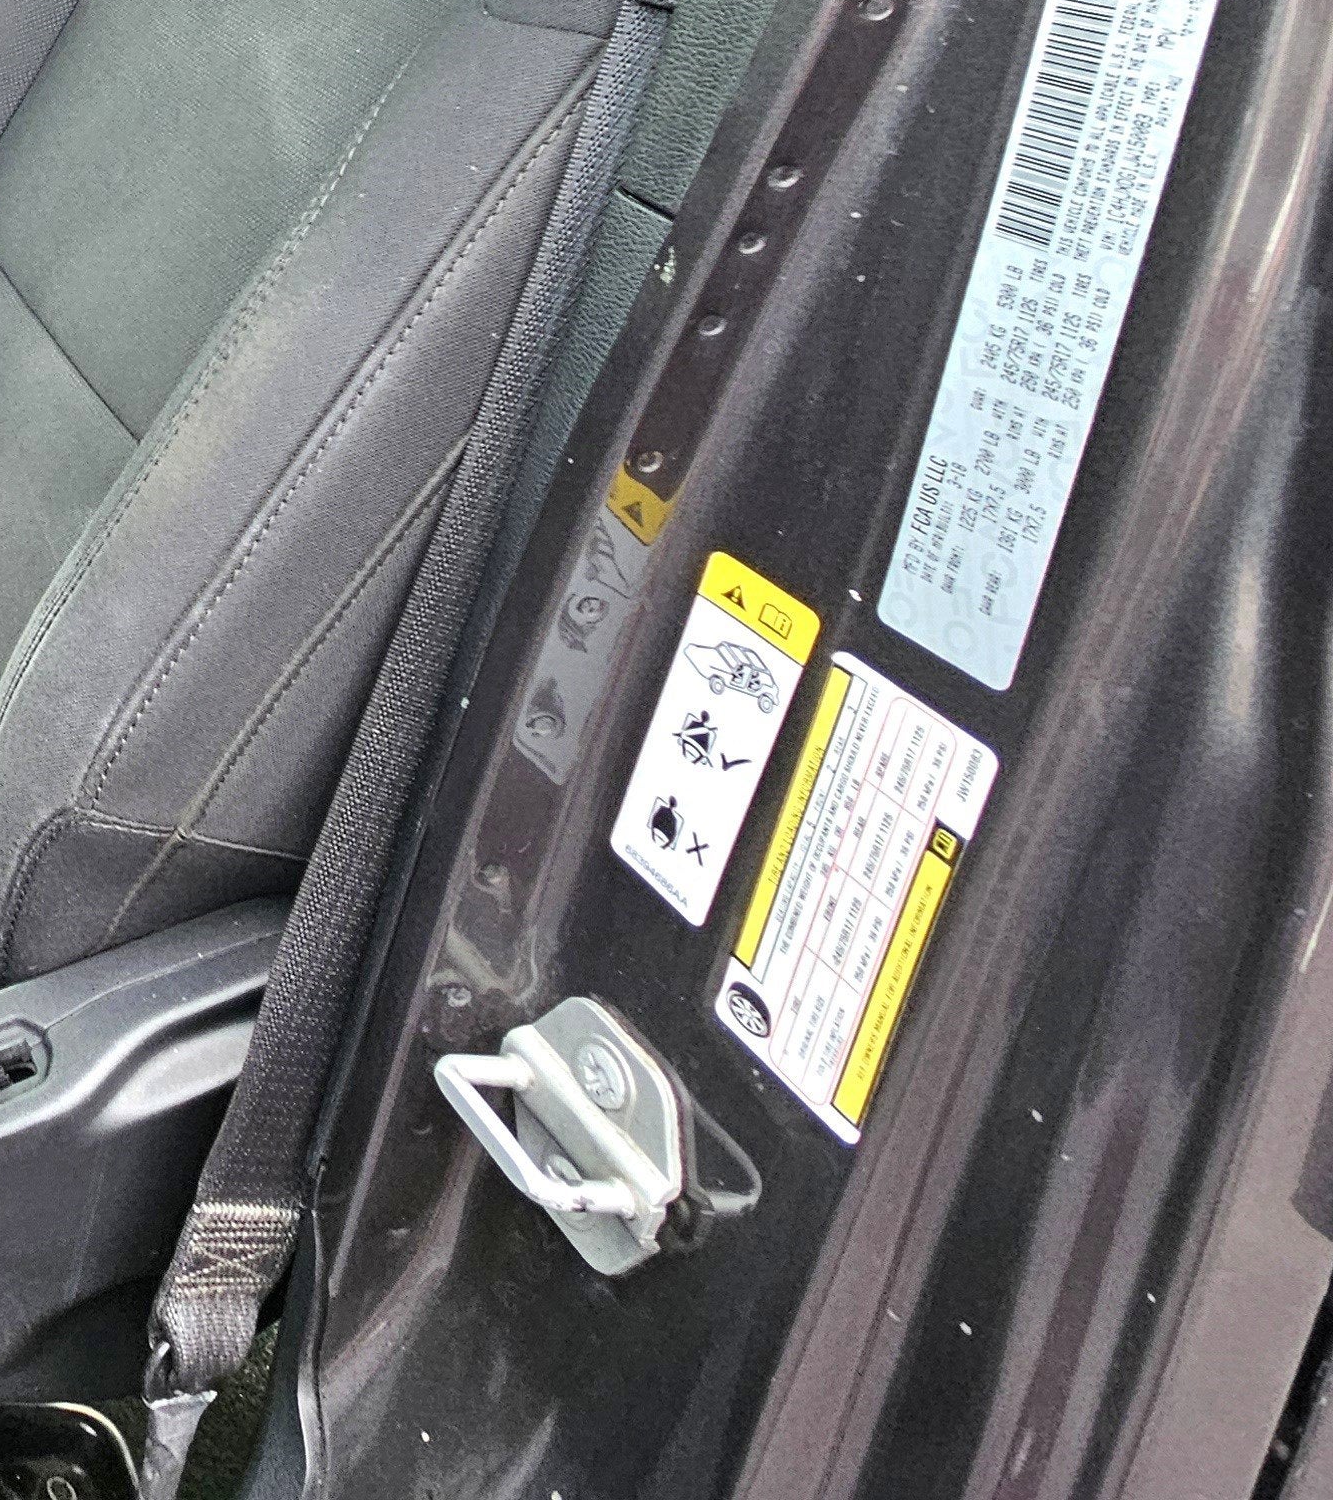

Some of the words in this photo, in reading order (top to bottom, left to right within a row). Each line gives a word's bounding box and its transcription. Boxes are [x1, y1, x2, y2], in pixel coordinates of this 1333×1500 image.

[1117, 2, 1141, 35] FEDERAL
[1132, 32, 1151, 53] DATE
[1155, 27, 1177, 50] MPV
[1127, 57, 1144, 71] THE
[1095, 72, 1120, 121] APPLICABLE
[1113, 90, 1134, 121] EFFECT
[1088, 126, 1105, 141] ALL
[1095, 139, 1121, 183] STANDARDS
[1072, 157, 1096, 197] CONFORMS
[1063, 199, 1084, 234] VEHICLE
[1081, 186, 1106, 235] PREVENTION
[1055, 236, 1073, 257] THIS
[1073, 237, 1092, 263] THEFT
[1005, 264, 1024, 281] LB
[1029, 258, 1048, 283] TIRES
[996, 283, 1018, 310] 5300
[1071, 272, 1091, 298] TIRES
[1017, 296, 1039, 324] 112S
[989, 323, 1007, 340] KG
[1059, 311, 1082, 340] 112S
[979, 341, 1002, 370] 2405
[1000, 326, 1029, 384] 245/75R17
[1041, 342, 1071, 401] 245/75R17
[981, 484, 1006, 524] 17X7.5
[1019, 369, 1039, 393] 250
[1035, 319, 1054, 336] 36
[1047, 272, 1066, 294] COLD
[1021, 503, 1046, 544] 17X7.5
[1060, 387, 1082, 410] 250
[1077, 335, 1097, 352] 36
[1091, 287, 1110, 309] COLD
[982, 430, 1000, 447] LB
[924, 454, 948, 484] LLC
[973, 447, 995, 476] 2700
[1022, 448, 1041, 466] LB
[946, 461, 968, 490] 3-18
[1013, 466, 1035, 495] 3000
[919, 482, 940, 506] US
[966, 487, 983, 504] KG
[910, 506, 934, 536] FCA
[957, 504, 979, 533] 1225
[1005, 506, 1023, 524] KG
[907, 535, 925, 553] BY
[996, 525, 1018, 553] 1361
[833, 772, 848, 800] CARGO
